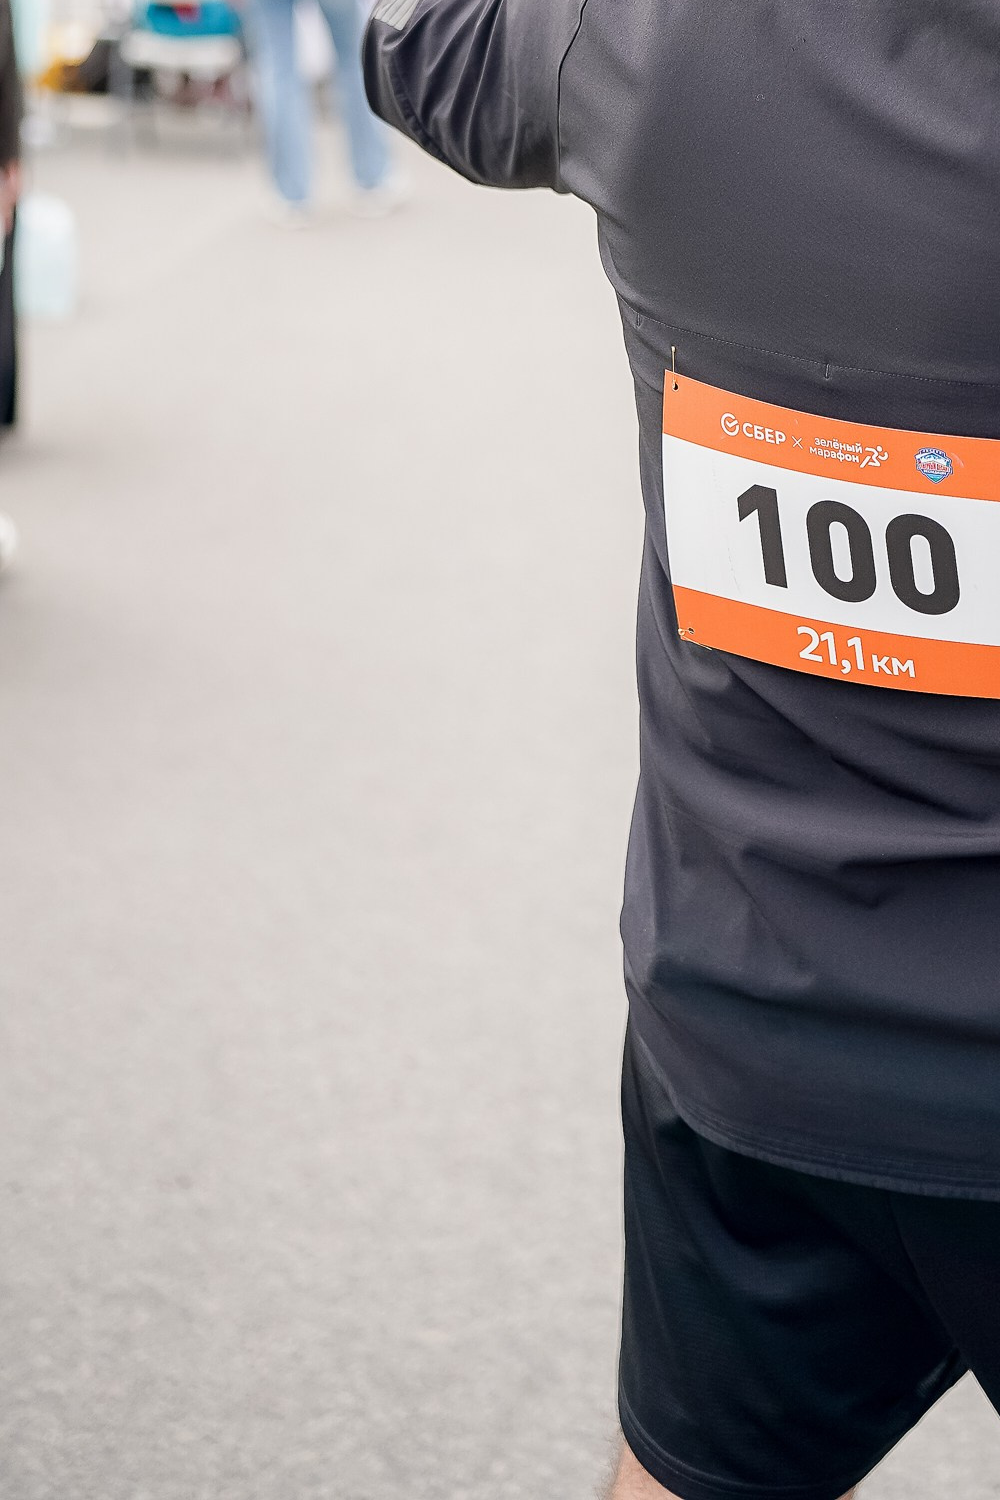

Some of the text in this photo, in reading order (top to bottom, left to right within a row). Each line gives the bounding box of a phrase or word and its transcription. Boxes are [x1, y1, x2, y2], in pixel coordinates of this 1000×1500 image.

[742, 422, 786, 445] СБЕР
[814, 436, 863, 454] зелёный
[809, 446, 860, 465] марафон
[737, 484, 960, 615] 100
[796, 626, 916, 678] 21,1 км
